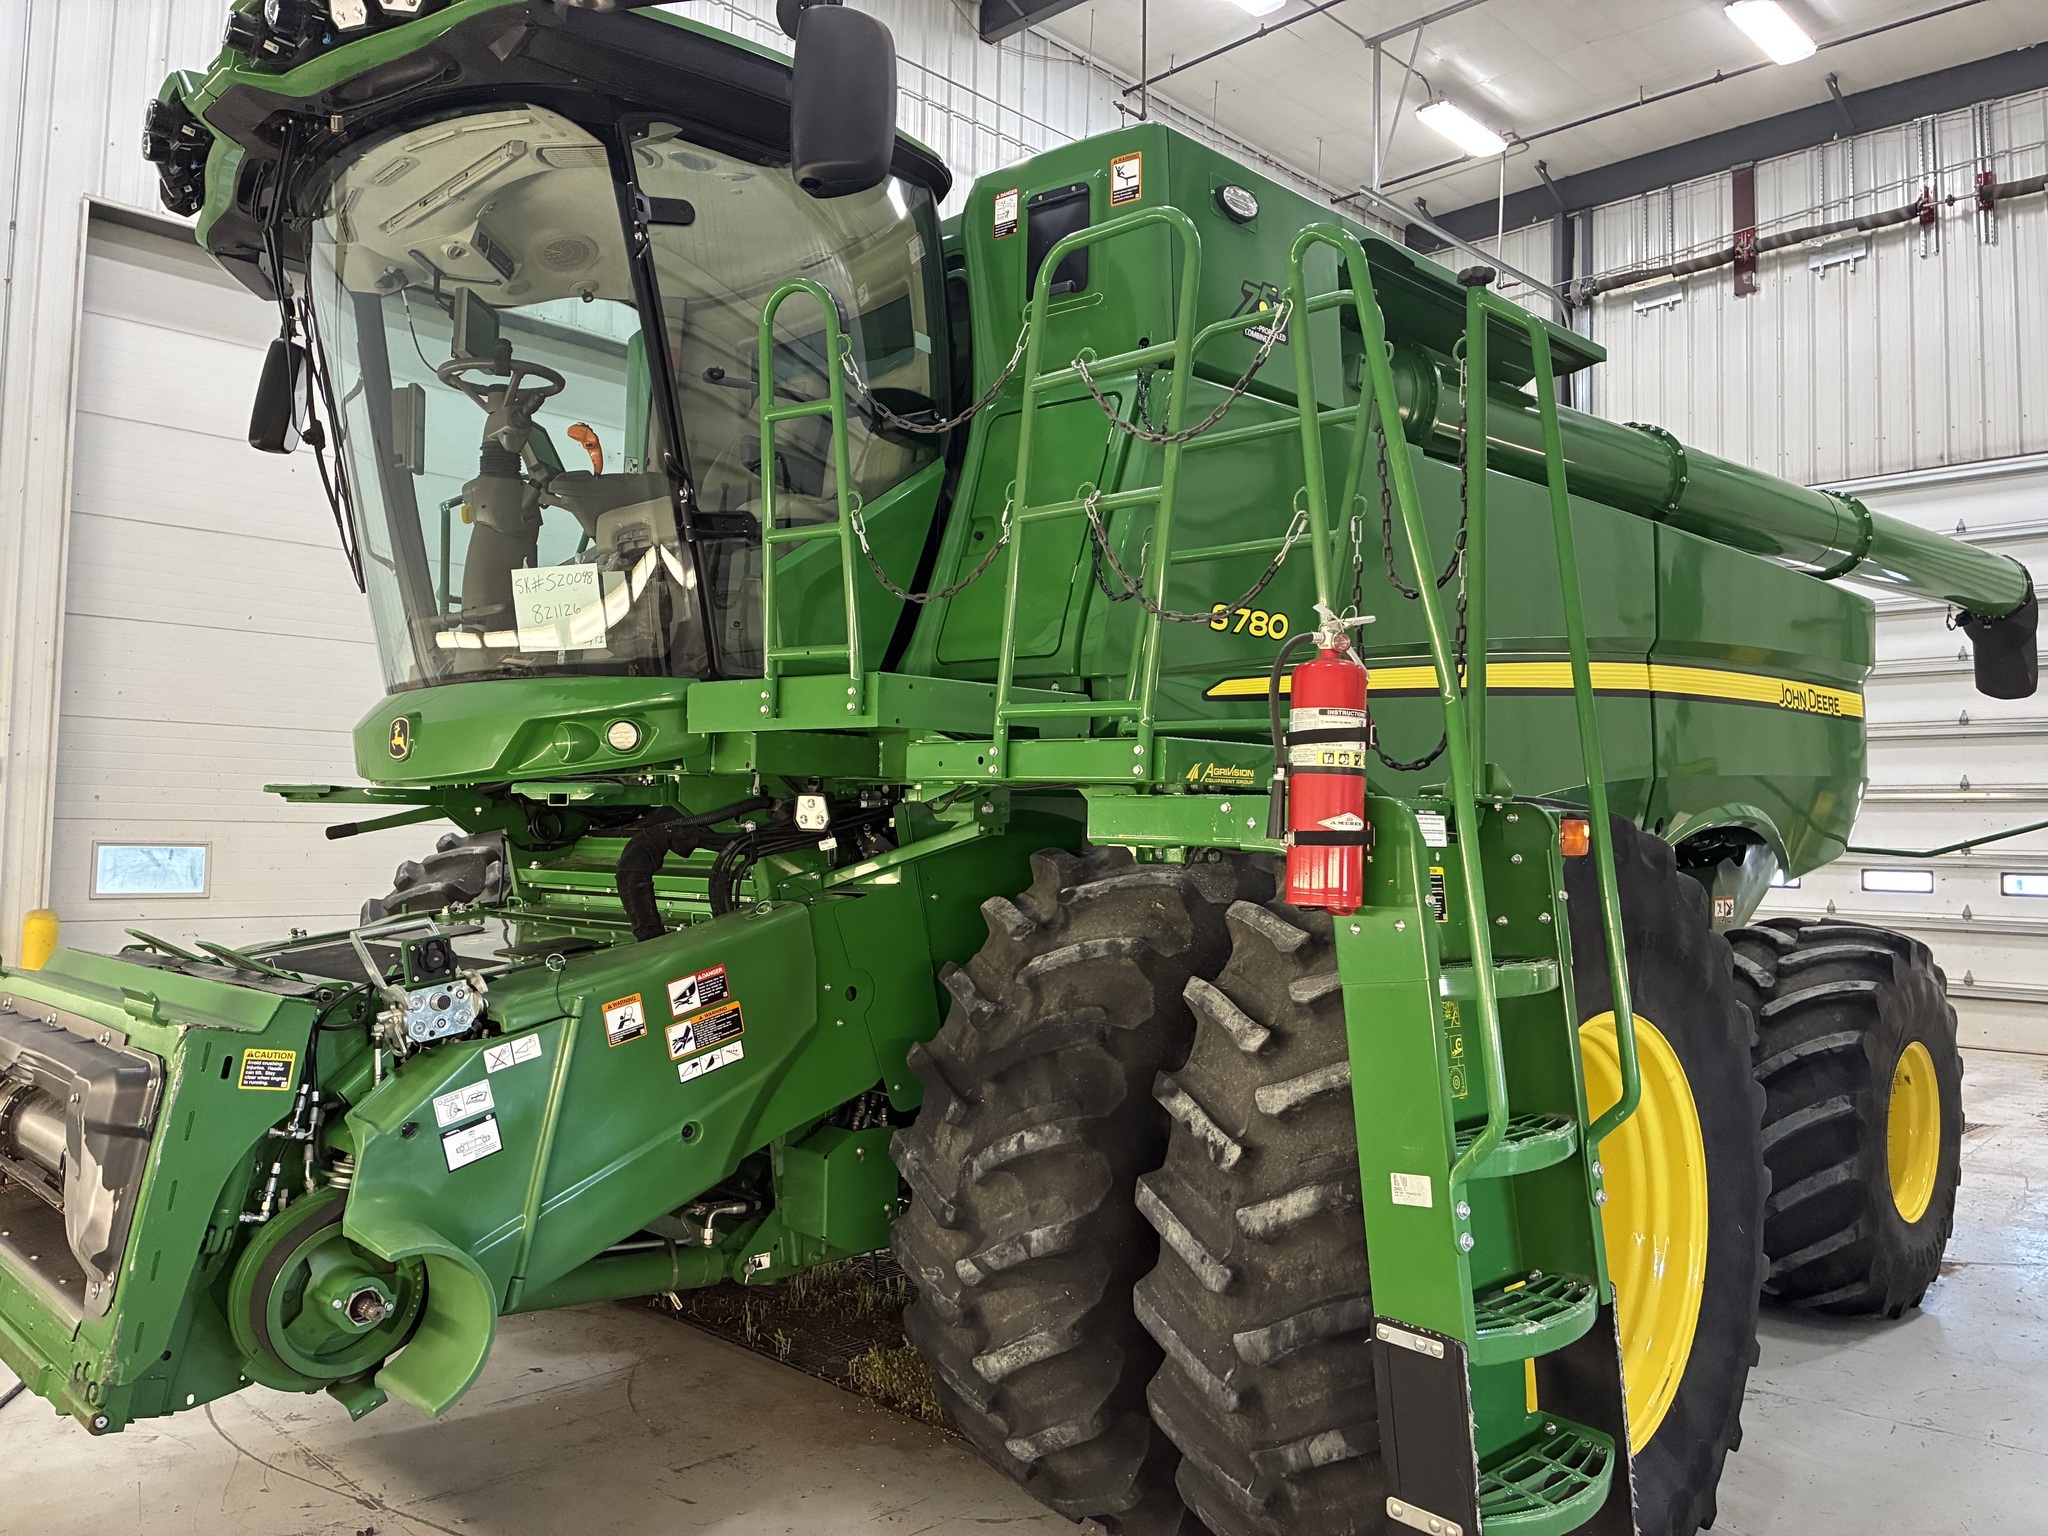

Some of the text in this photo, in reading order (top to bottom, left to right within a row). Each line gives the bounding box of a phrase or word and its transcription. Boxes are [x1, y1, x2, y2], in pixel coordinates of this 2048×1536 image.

[1118, 153, 1140, 162] WARNING
[1000, 189, 1018, 198] DANGER
[532, 603, 582, 624] 821126
[1209, 602, 1290, 641] S780
[1779, 683, 1841, 713] JOHN DEERE
[701, 967, 723, 980] DANGER
[612, 996, 637, 1008] WARNING
[704, 1006, 728, 1019] WARNING
[254, 1051, 294, 1060] CAUTION
